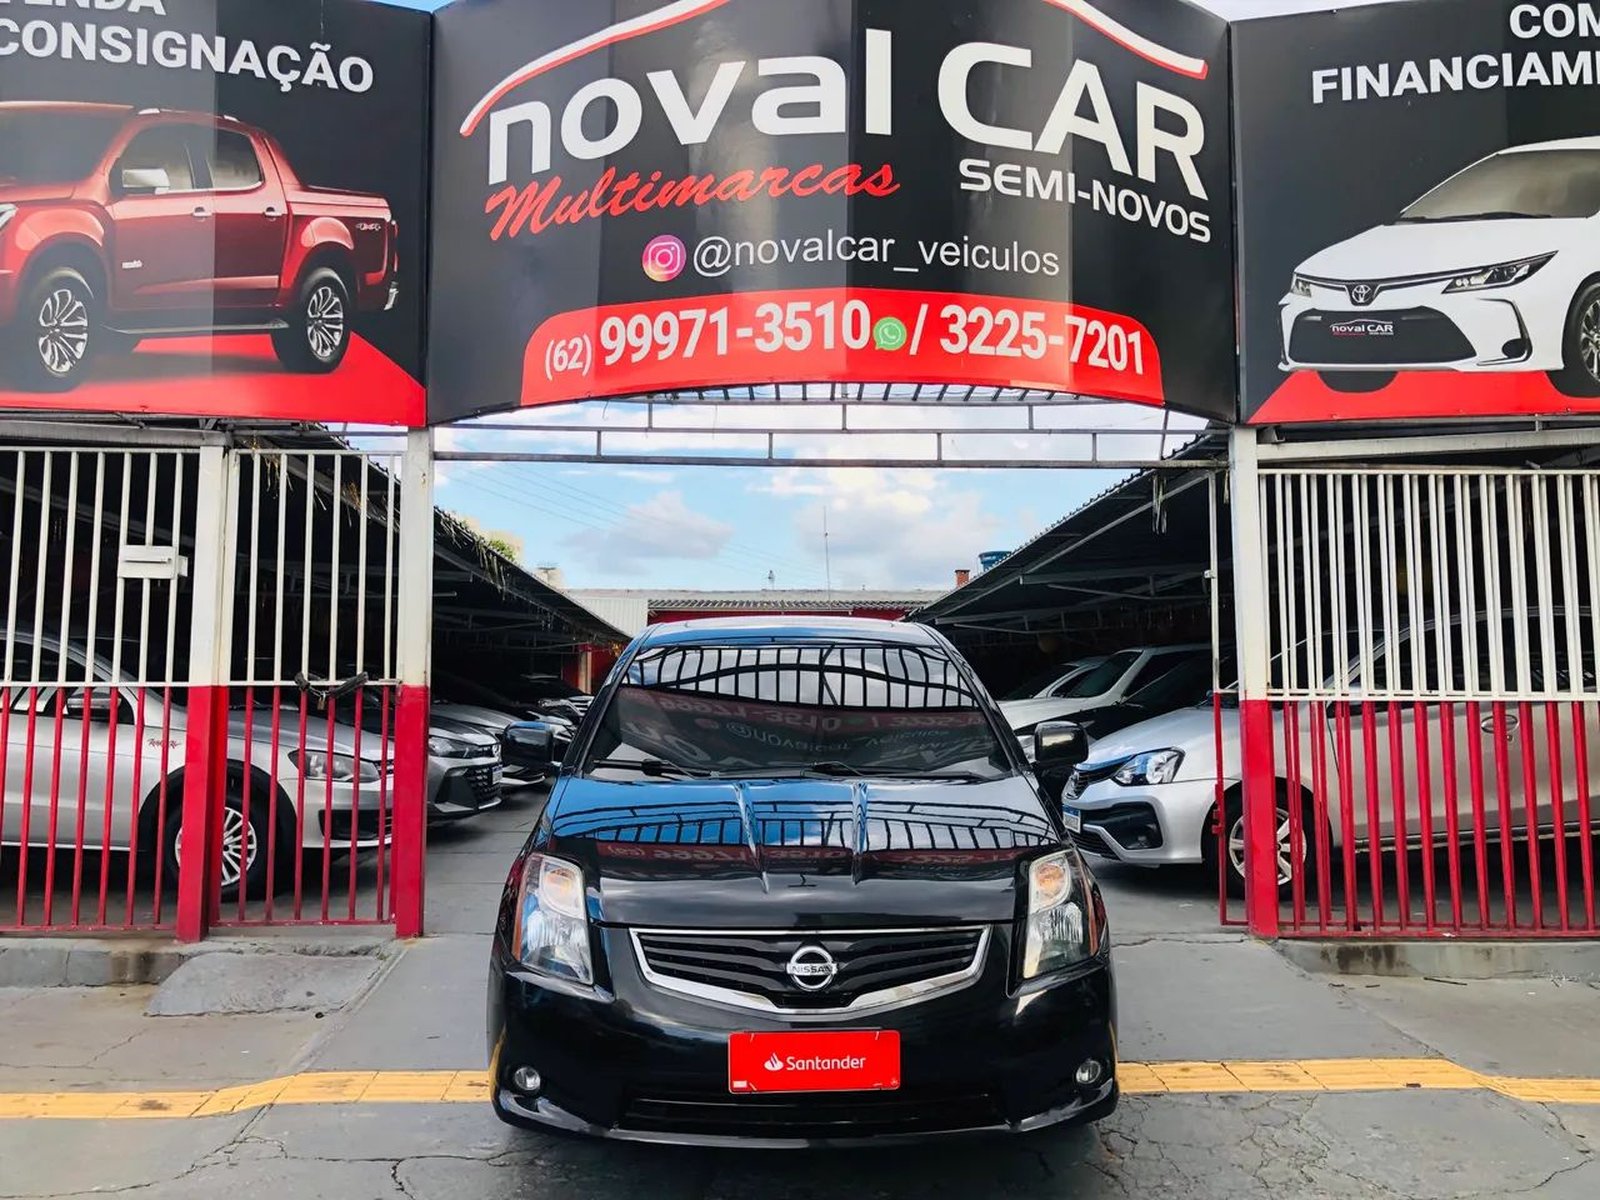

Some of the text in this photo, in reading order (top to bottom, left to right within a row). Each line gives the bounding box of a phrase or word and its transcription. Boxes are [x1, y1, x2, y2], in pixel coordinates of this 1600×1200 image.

[1312, 51, 1600, 104] FINANCIAM
[488, 28, 1208, 200] noval CAR
[485, 163, 901, 241] Multimarcas
[959, 158, 1211, 244] SEMI-NOVOS
[693, 228, 1060, 278] @novalcar_veiculos
[545, 333, 593, 381] (62)
[600, 299, 871, 366] 99971-3510
[940, 304, 1144, 375] 3225-7201
[1367, 324, 1393, 332] CAR
[791, 965, 833, 974] NISSAN
[786, 1055, 867, 1071] Santander
